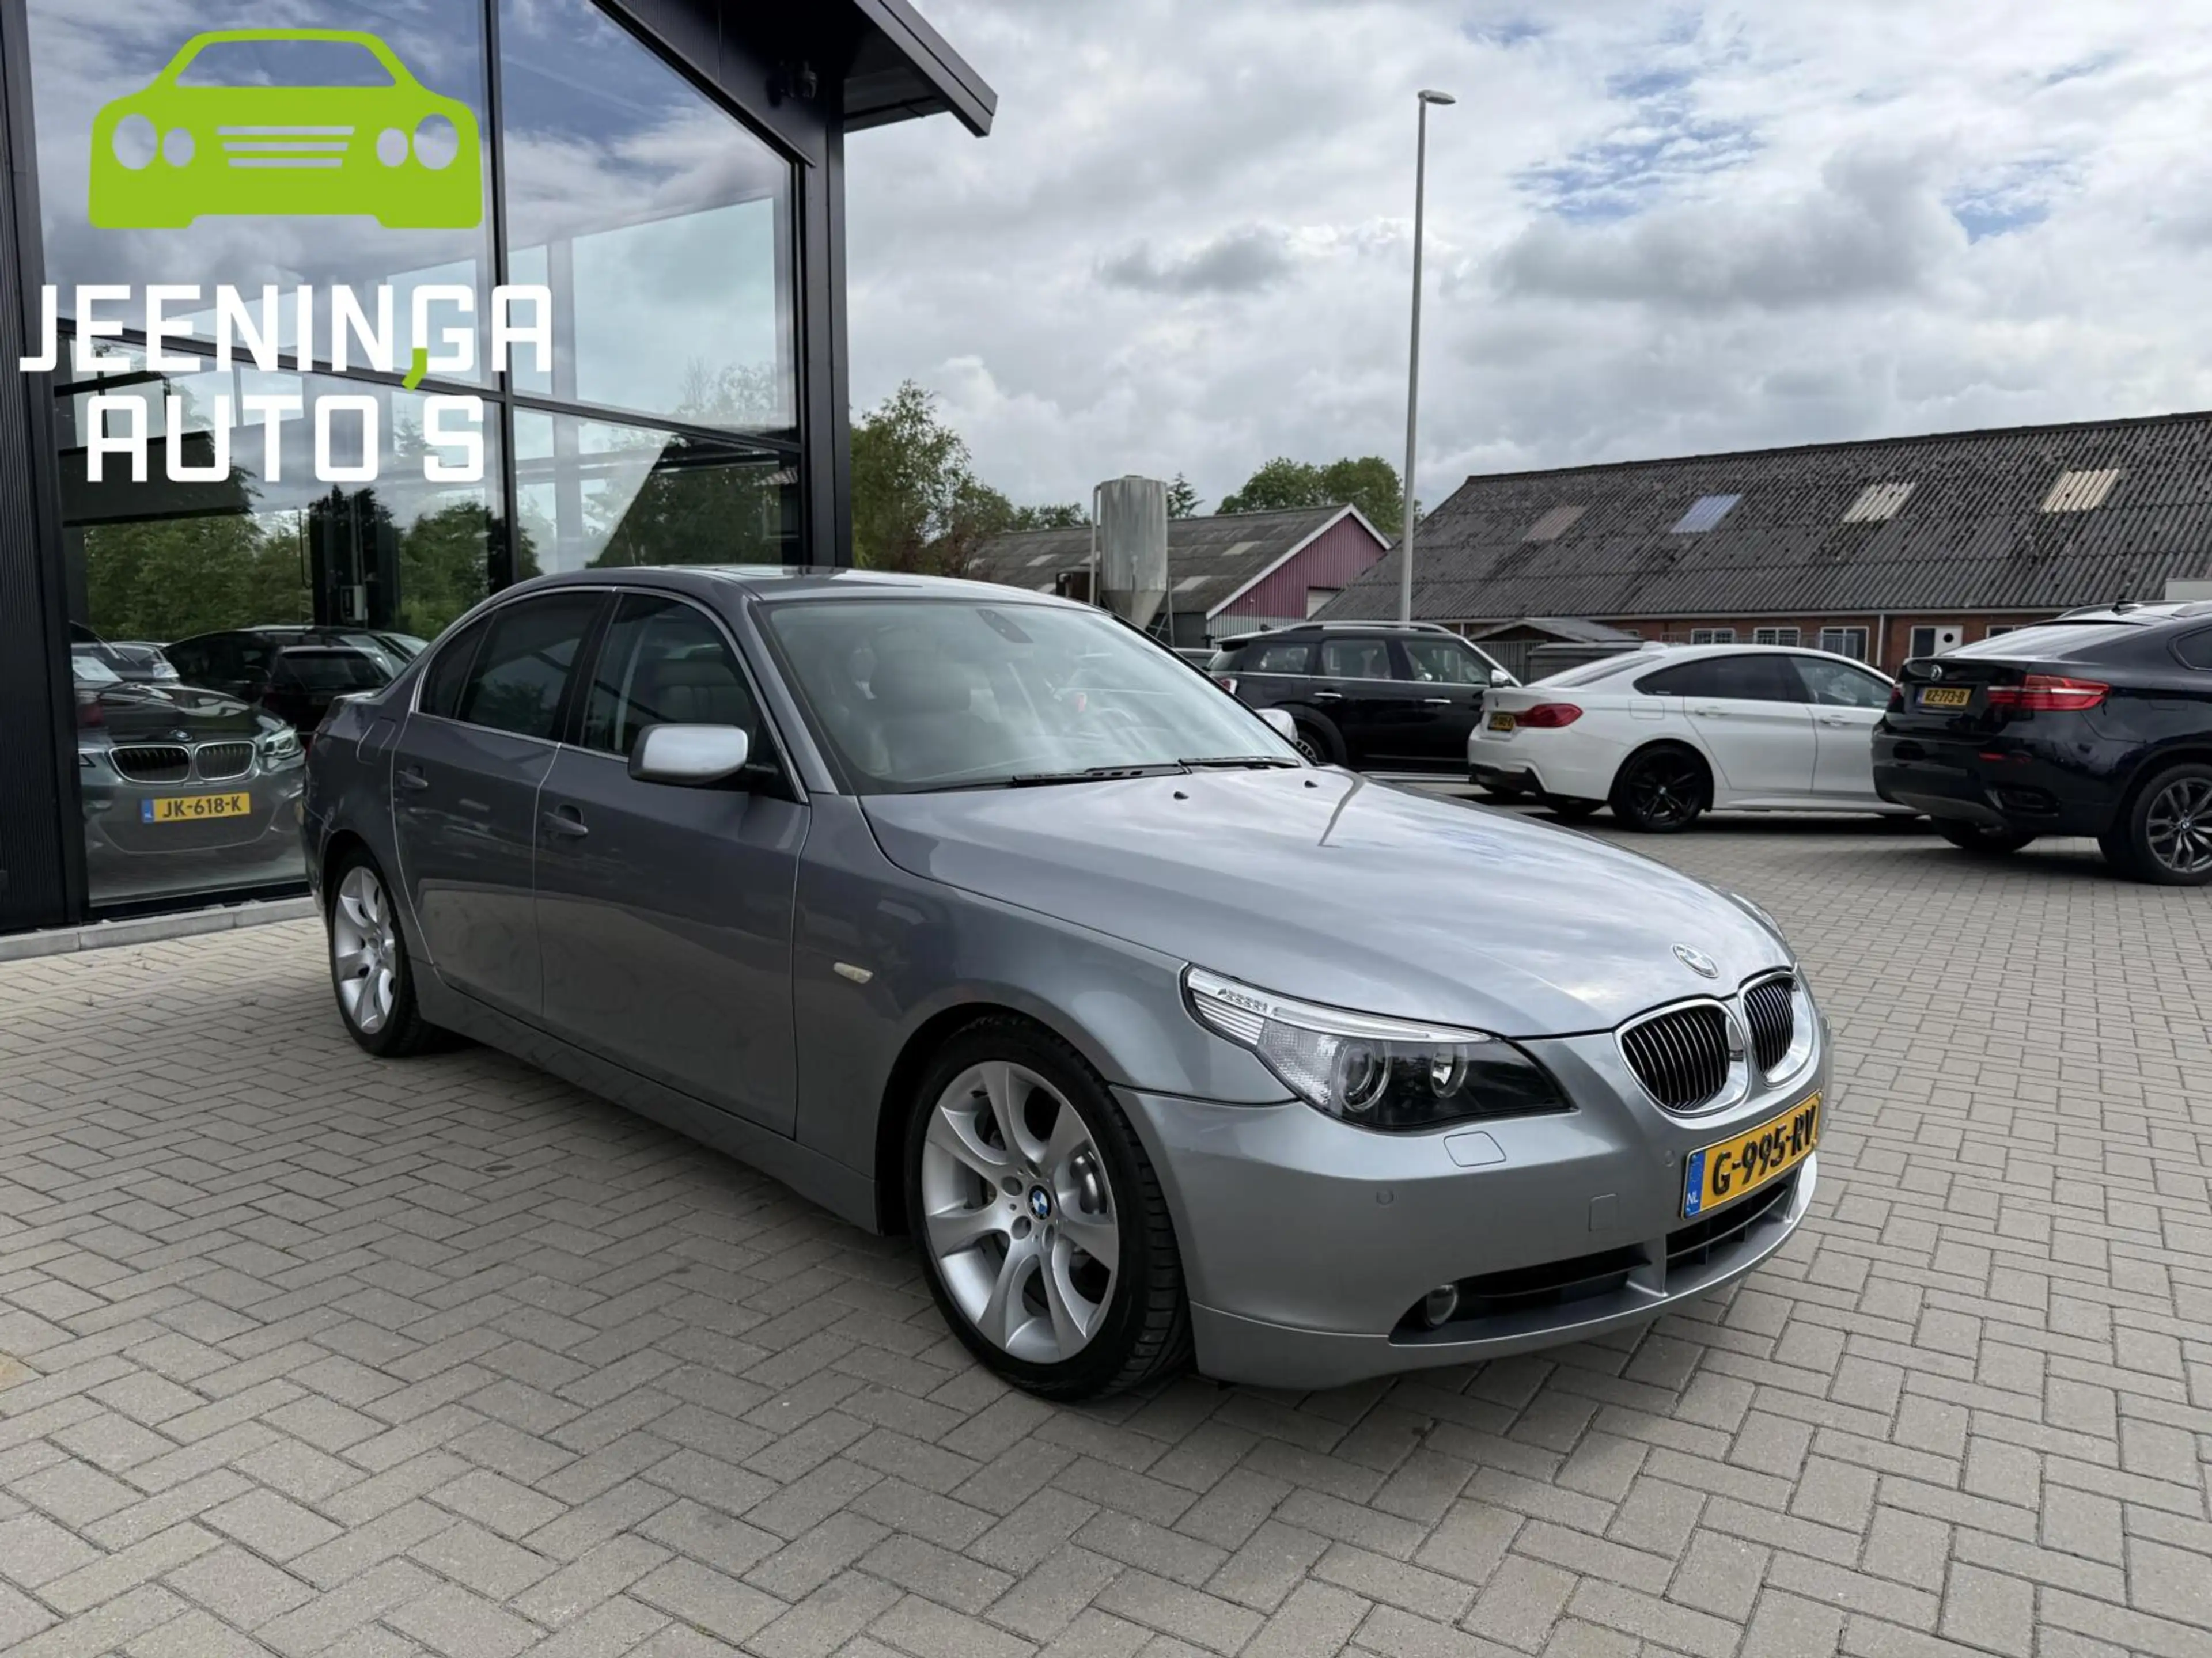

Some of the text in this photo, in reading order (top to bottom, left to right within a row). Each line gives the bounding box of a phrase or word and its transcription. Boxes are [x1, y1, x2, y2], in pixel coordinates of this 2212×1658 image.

[162, 795, 242, 818] JK-618-K
[1712, 1104, 1816, 1196] G-995-RV
[1686, 1190, 1699, 1205] NL
